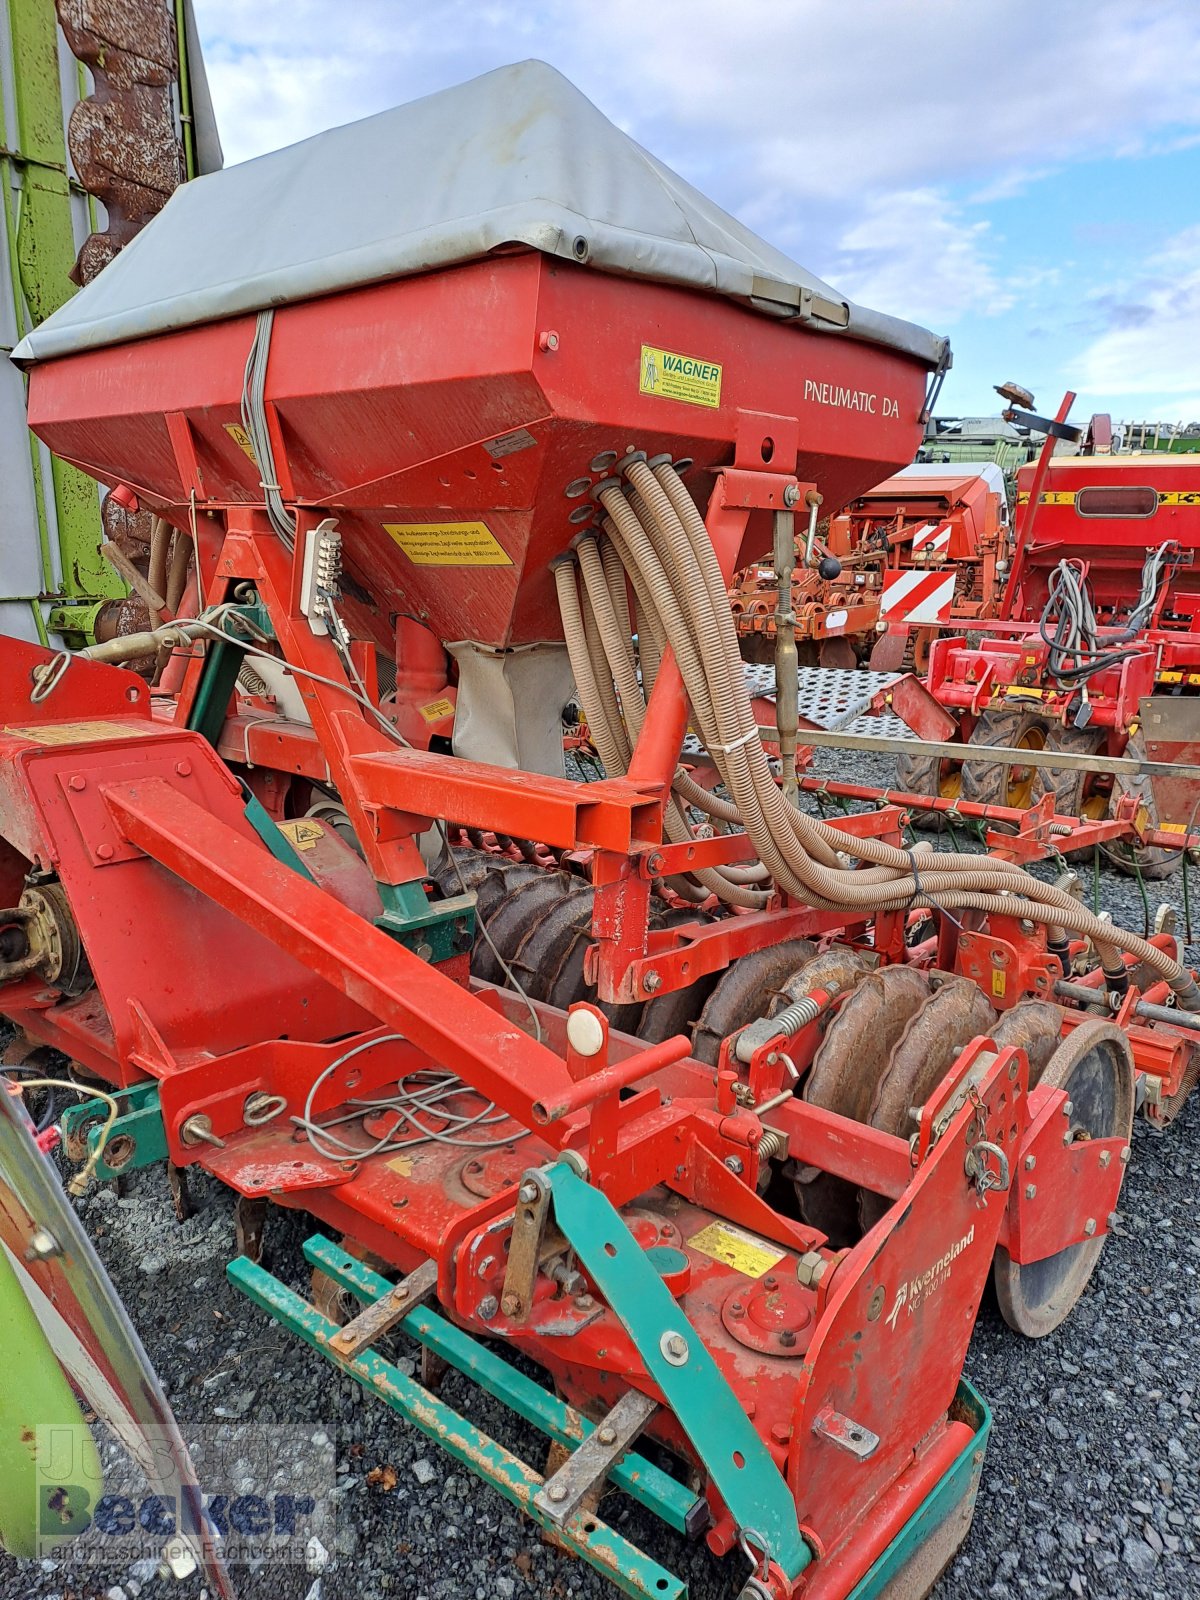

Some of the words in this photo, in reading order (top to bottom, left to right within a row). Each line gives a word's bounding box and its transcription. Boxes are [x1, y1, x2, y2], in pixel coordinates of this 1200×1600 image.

[663, 354, 719, 382] WAGNER
[804, 379, 877, 414] PNEUMATIC
[882, 397, 900, 418] DA
[909, 1224, 975, 1300] Kverneland
[907, 1295, 921, 1317] NG
[924, 1279, 939, 1299] 300
